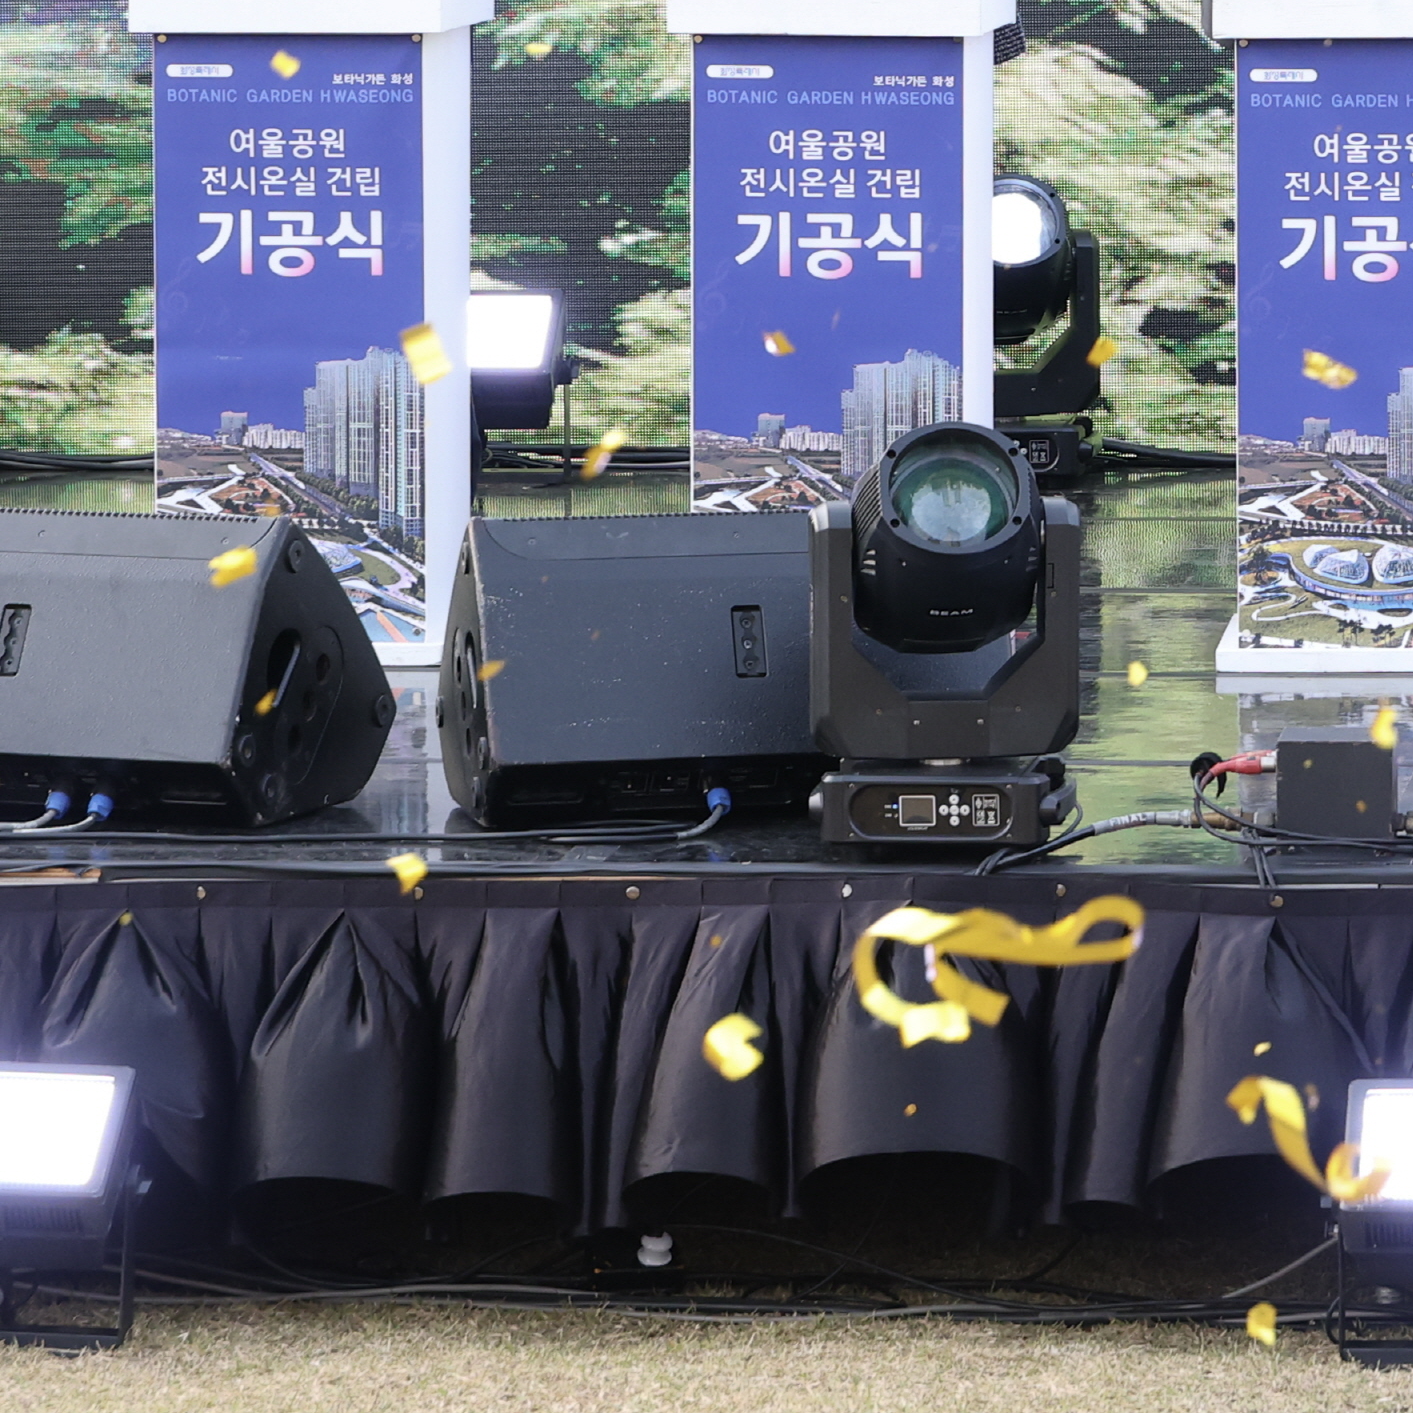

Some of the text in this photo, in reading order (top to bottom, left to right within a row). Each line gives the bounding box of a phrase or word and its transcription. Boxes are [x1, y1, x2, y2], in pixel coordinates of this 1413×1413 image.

[333, 73, 413, 85] 보타닉가든 화성
[873, 76, 954, 87] 보타닉가든 화성
[167, 89, 413, 103] BOTANIC GARDEN HWASEONG
[707, 90, 954, 105] BOTANIC GARDEN HWASEONG
[1251, 94, 1322, 107] BOTANIC
[1332, 94, 1398, 107] GARDEN
[230, 128, 345, 158] 여울공원
[769, 129, 886, 160] 여울공원
[201, 167, 380, 196] 전시온실 건립
[740, 167, 920, 198] 전시온실 건립
[1285, 172, 1400, 201] 전시온실
[196, 209, 383, 277] 기공식
[735, 212, 922, 279] 기공식
